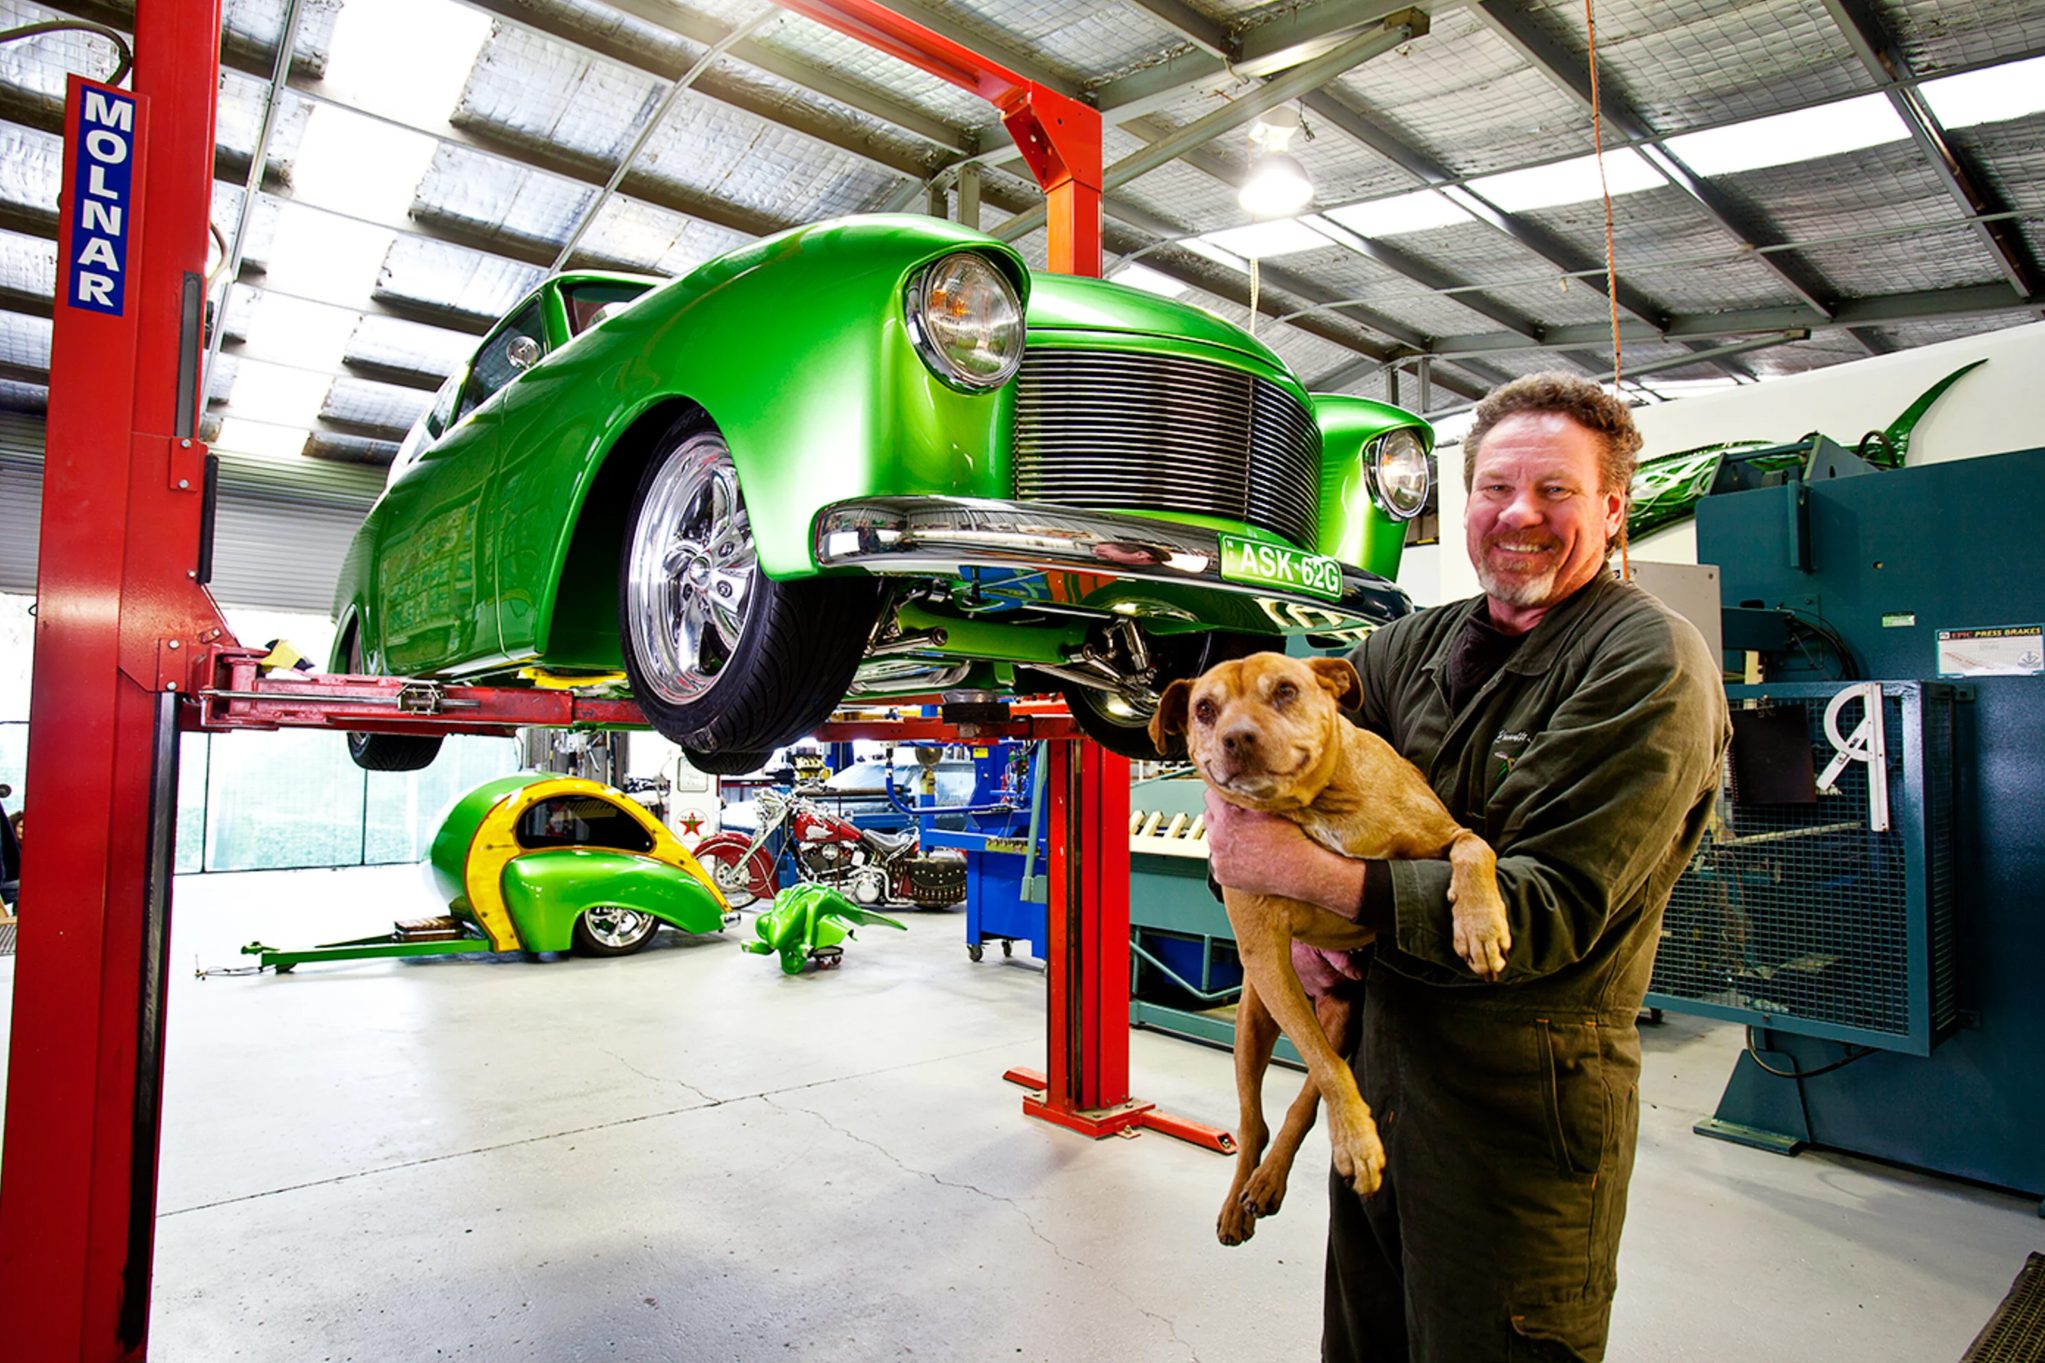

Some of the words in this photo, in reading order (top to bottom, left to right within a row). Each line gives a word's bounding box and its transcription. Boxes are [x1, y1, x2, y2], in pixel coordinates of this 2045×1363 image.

[77, 90, 133, 307] MOLNAR
[1974, 629, 2002, 638] PRESS
[2004, 627, 2041, 636] BRAKES
